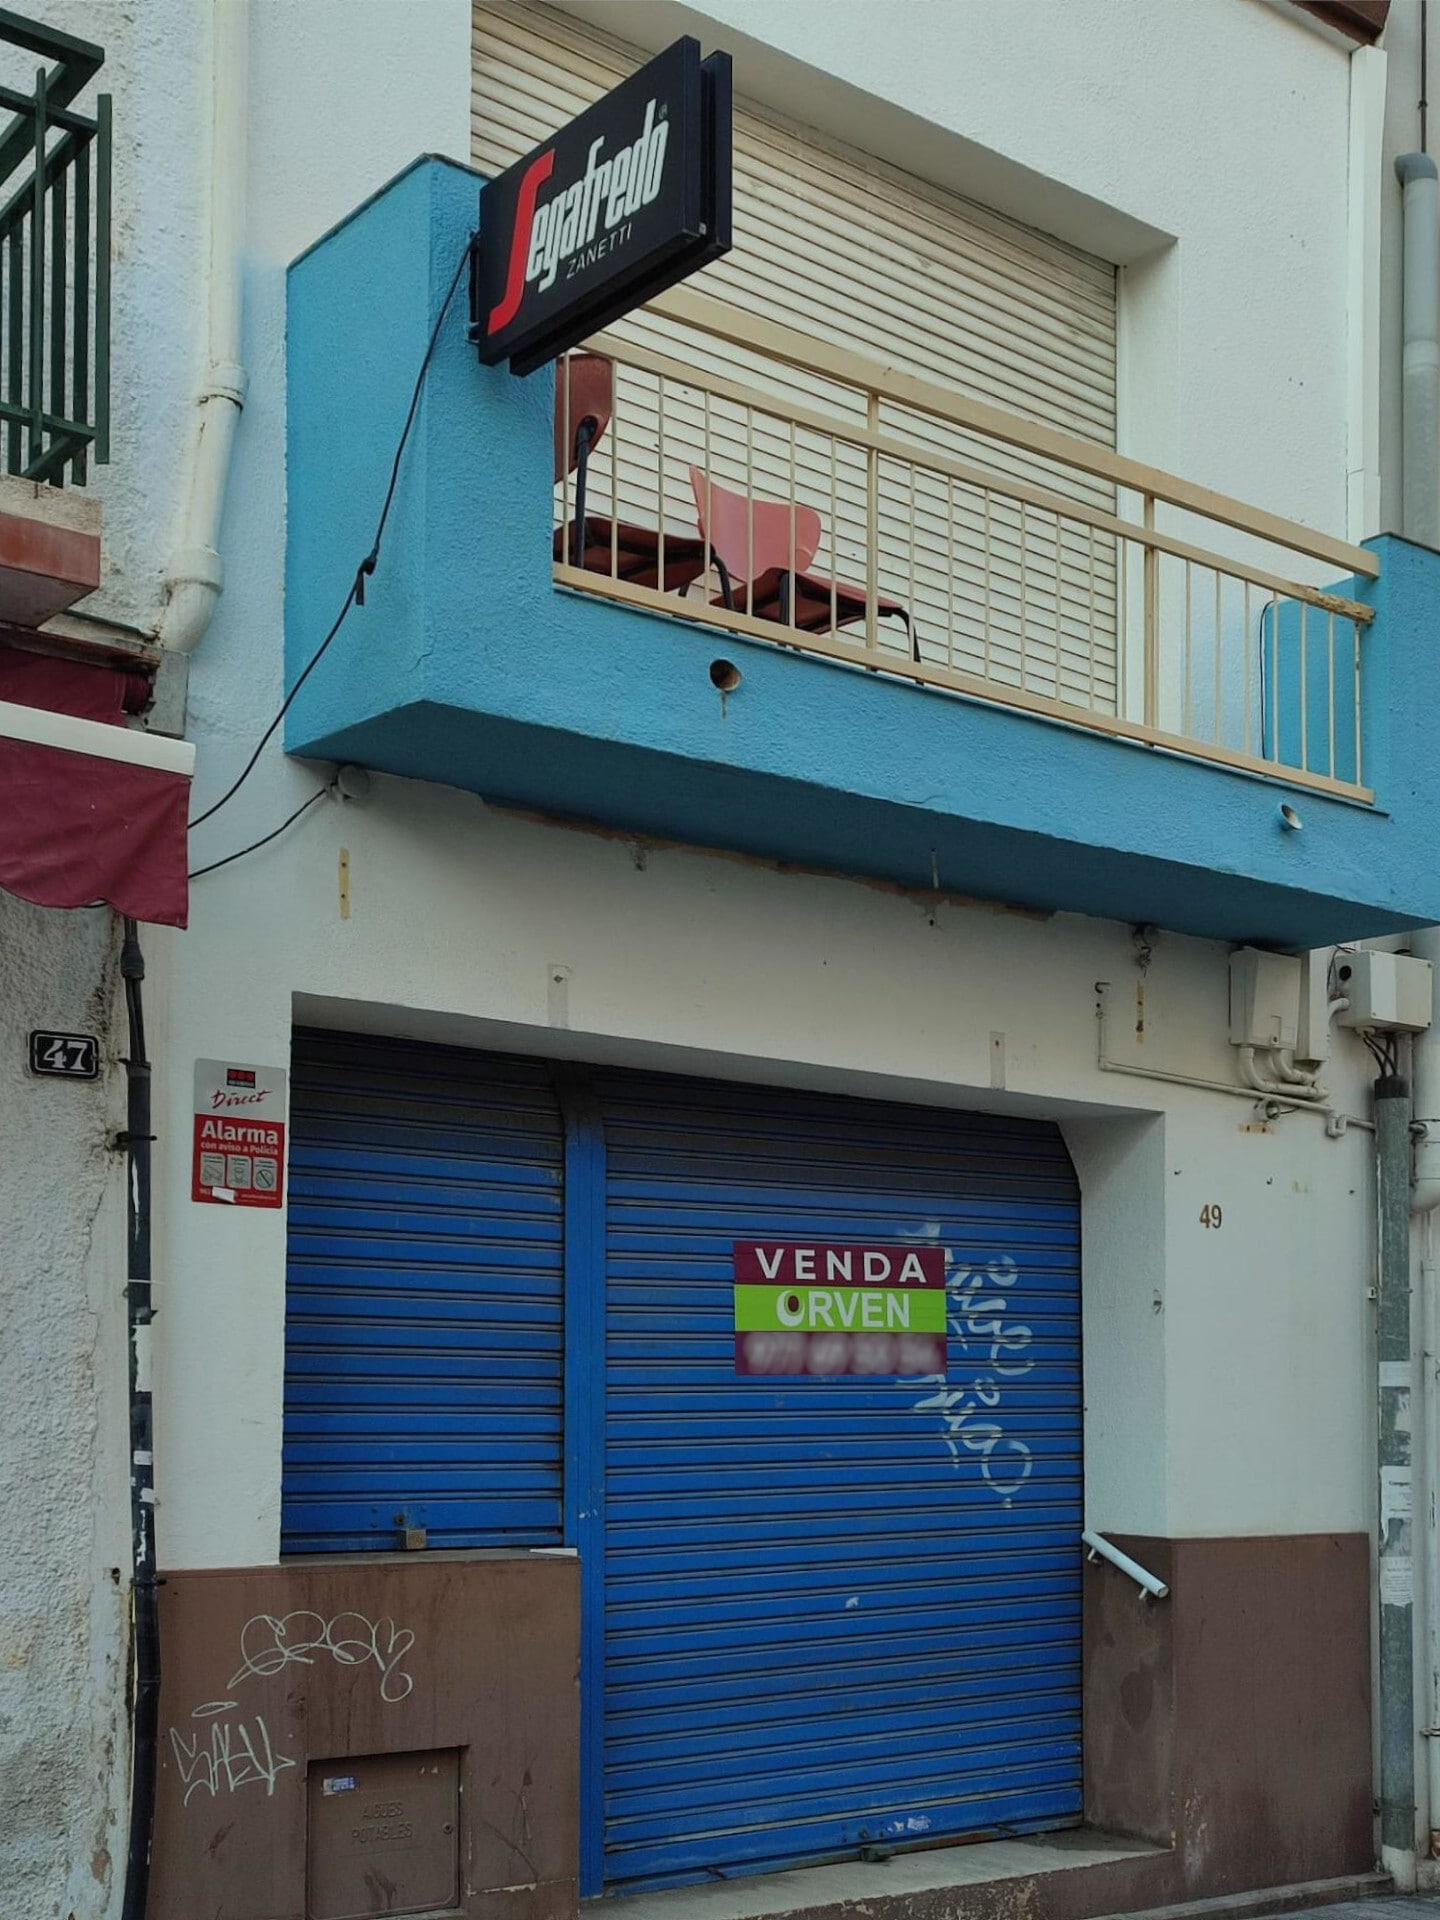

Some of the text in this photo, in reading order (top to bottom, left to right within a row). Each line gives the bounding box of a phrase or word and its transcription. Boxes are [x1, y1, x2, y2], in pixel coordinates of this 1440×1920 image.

[487, 98, 670, 336] Segafredo
[566, 222, 632, 279] ZANETTI
[43, 1040, 88, 1070] 47
[211, 1090, 272, 1109] Direct
[201, 1120, 279, 1145] Alarma
[200, 1141, 217, 1150] con
[218, 1142, 241, 1152] aviso
[242, 1145, 249, 1153] a
[1200, 1204, 1222, 1229] 49
[755, 1247, 927, 1283] VENDA
[776, 1289, 910, 1328] ORVEN
[351, 1822, 413, 1844] POTABLES
